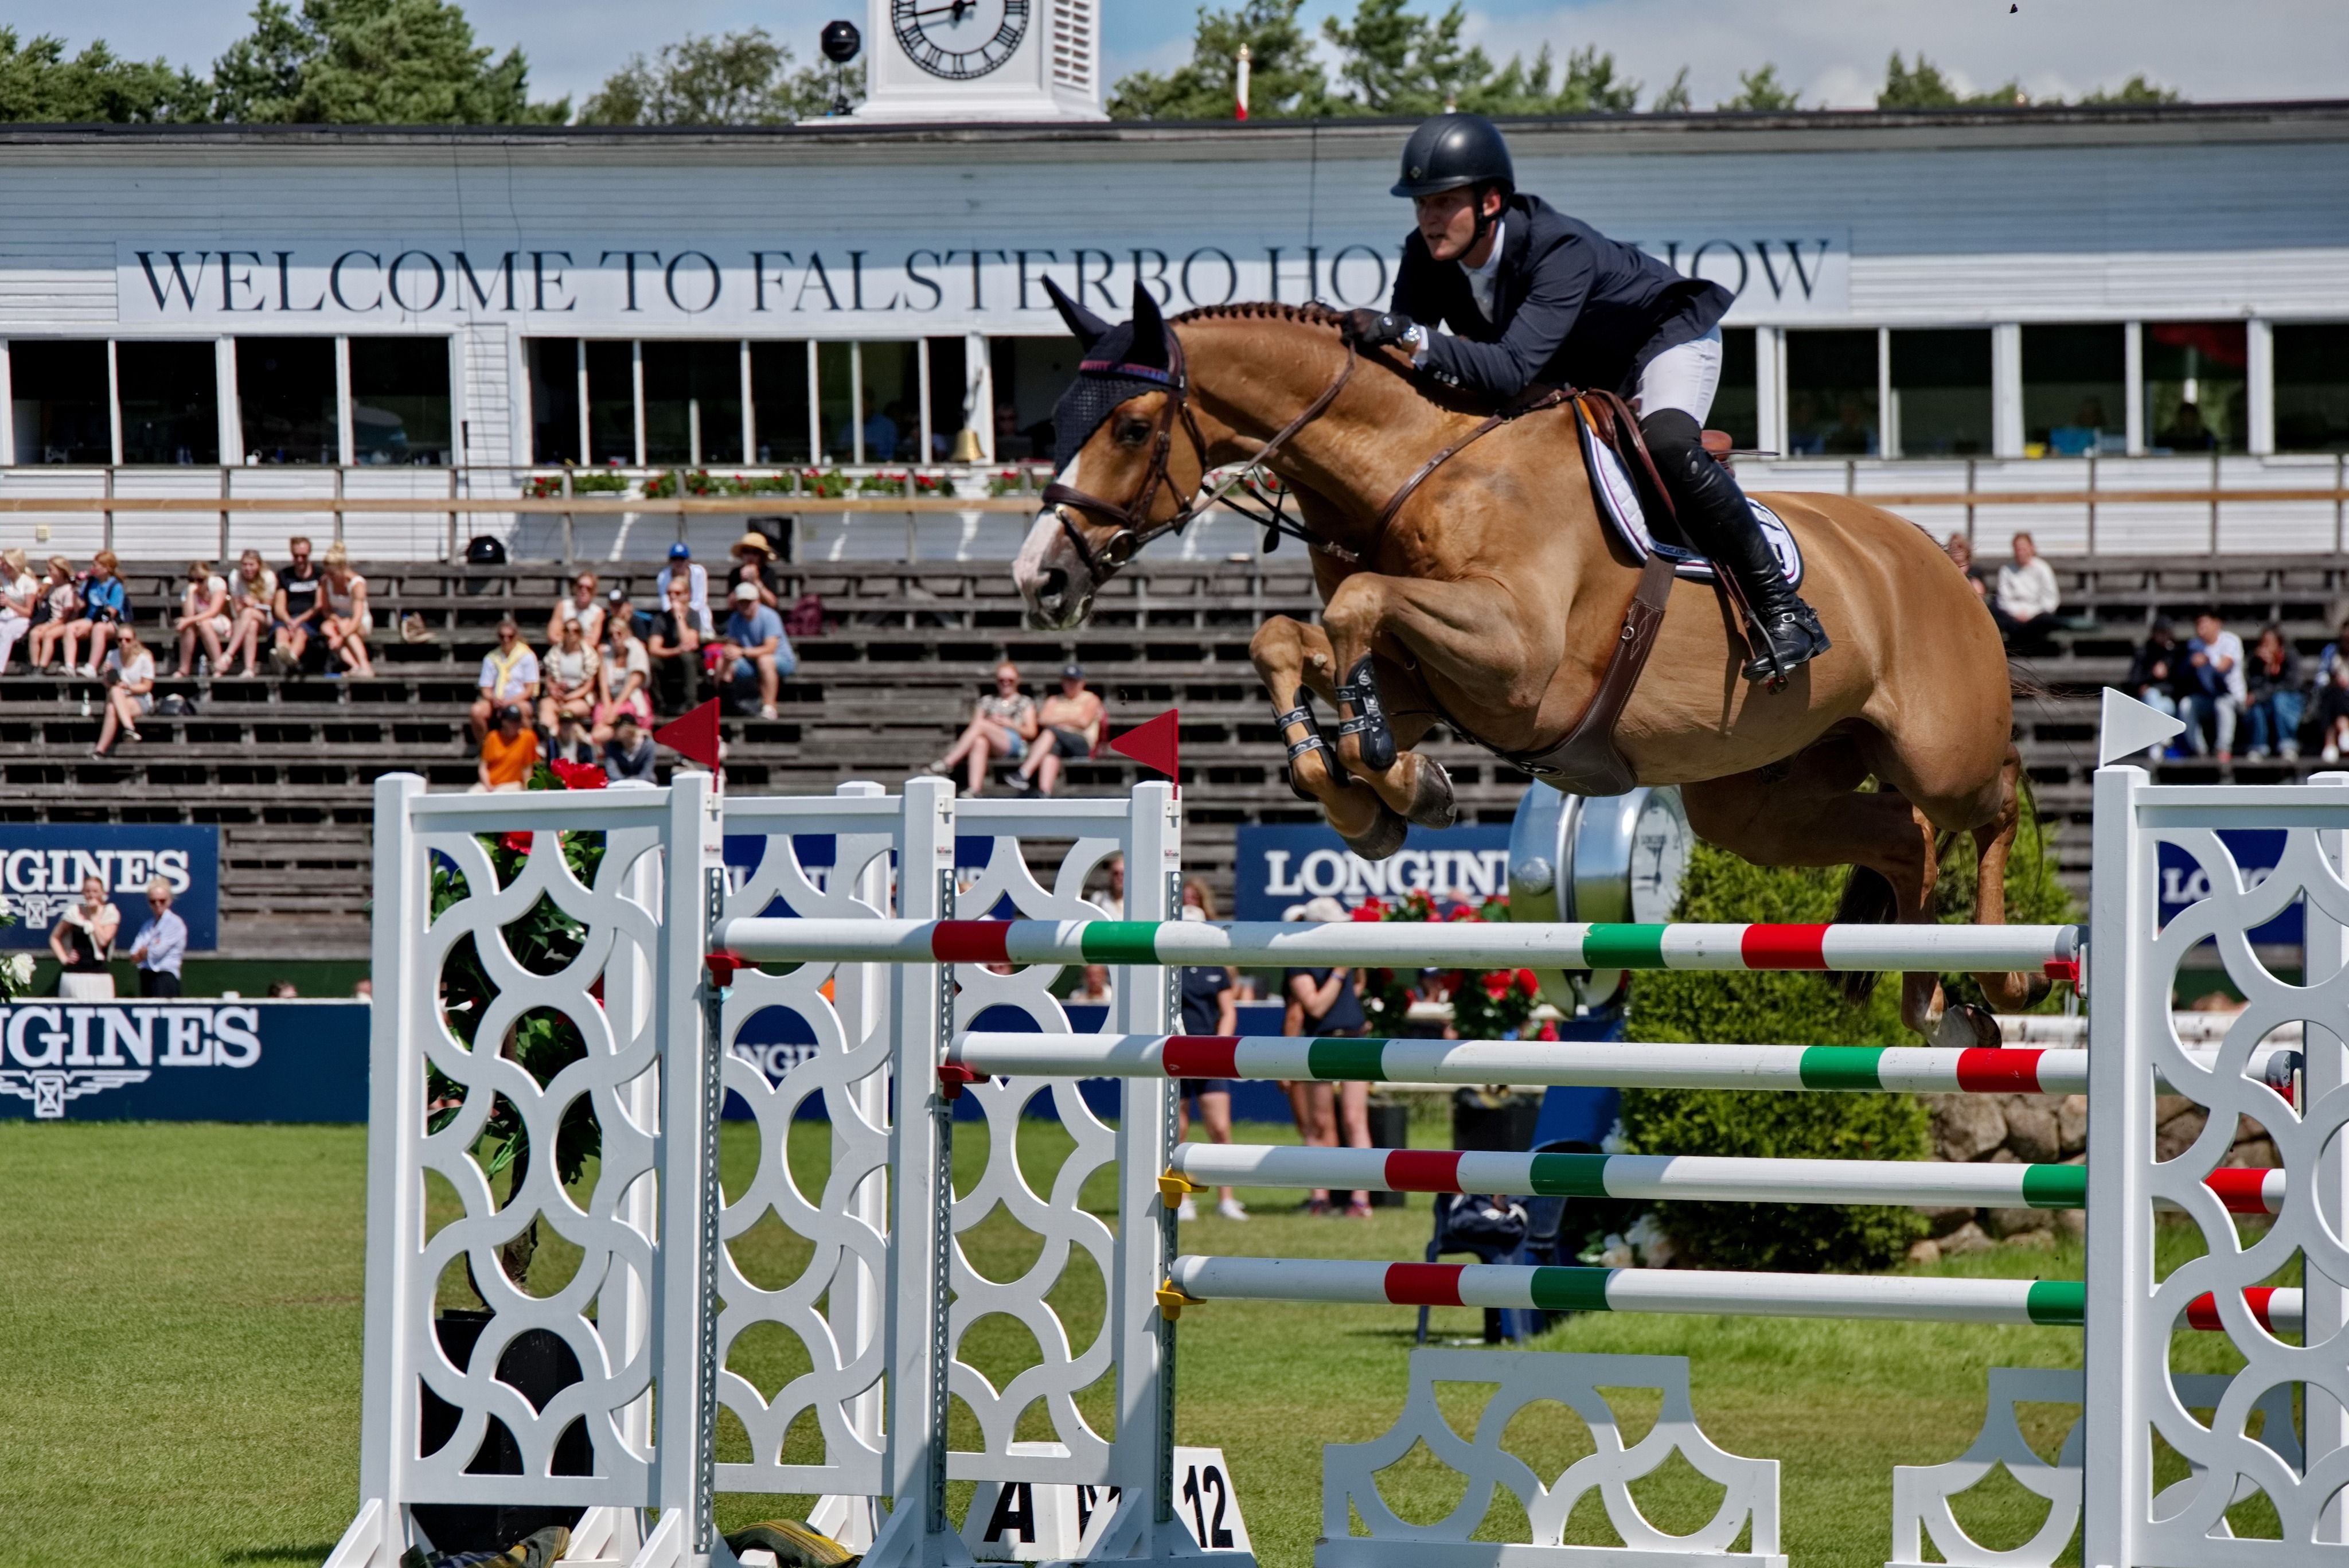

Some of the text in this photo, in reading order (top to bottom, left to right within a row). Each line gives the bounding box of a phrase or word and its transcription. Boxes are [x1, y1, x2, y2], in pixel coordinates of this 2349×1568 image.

[134, 249, 577, 313] WELCOME
[599, 250, 721, 314] TO
[748, 246, 1238, 312] FALSTERBO
[1263, 244, 1406, 307] HO
[0, 849, 190, 894] GINES
[1264, 849, 1511, 896] LONGIN
[0, 1006, 261, 1068] GINES
[983, 1482, 1035, 1543] A
[1183, 1465, 1234, 1548] 12
